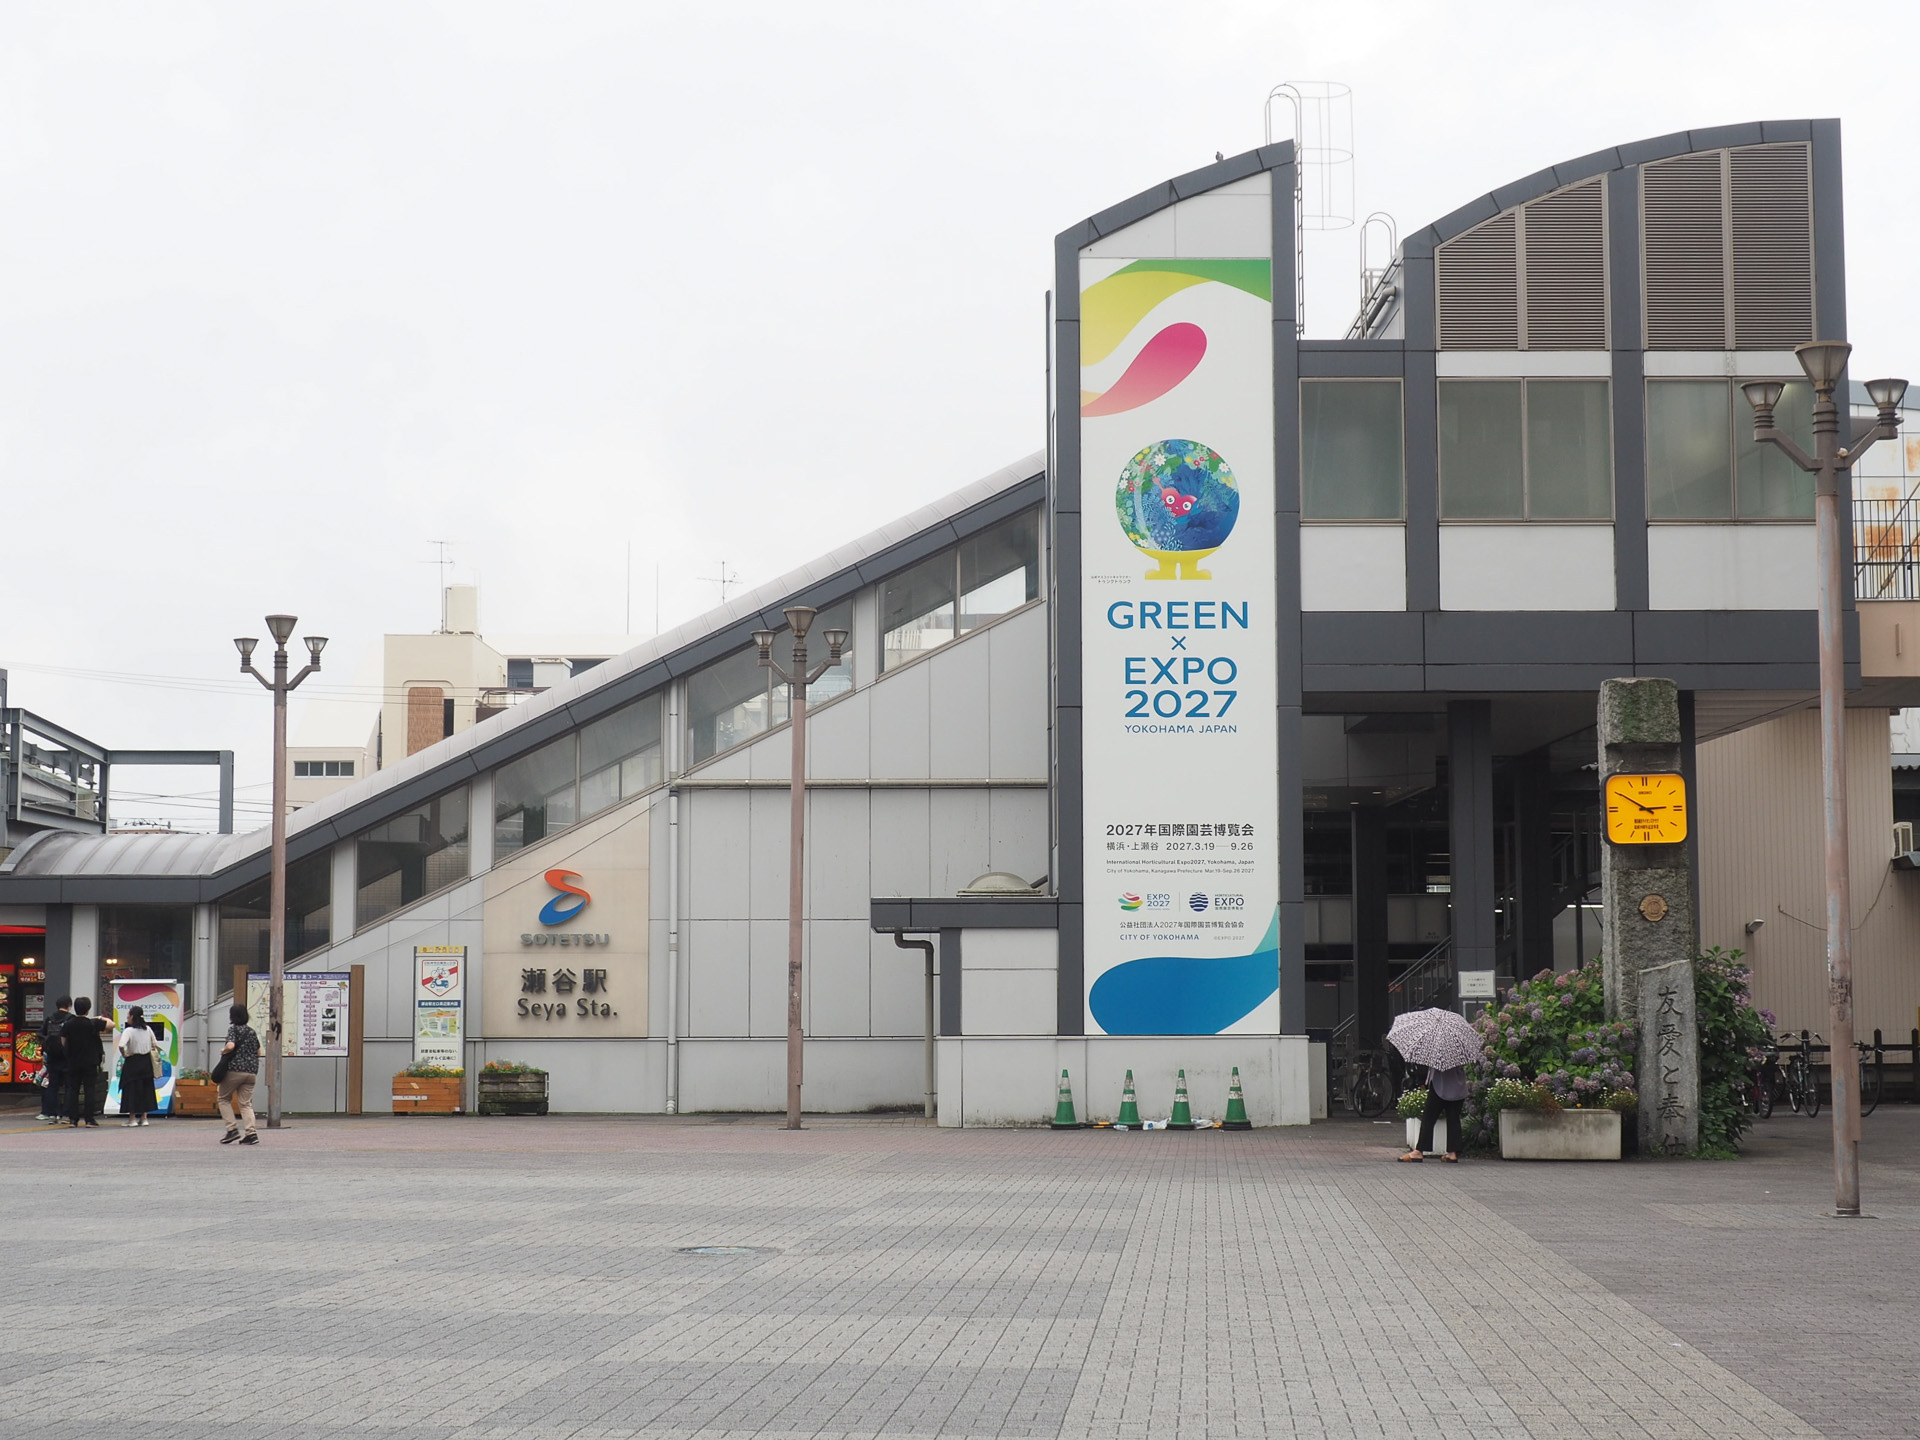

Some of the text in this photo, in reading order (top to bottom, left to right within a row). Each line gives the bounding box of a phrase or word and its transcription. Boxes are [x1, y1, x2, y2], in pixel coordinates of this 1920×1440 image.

[1107, 601, 1248, 629] GREEN
[1125, 657, 1238, 685] EXPO
[1125, 690, 1237, 718] 2027
[1125, 725, 1237, 733] YOKOHAMA JAPAN
[1106, 823, 1254, 837] 2027年国際園芸博覧会
[1106, 841, 1159, 851] 横浜・上瀬谷
[1214, 898, 1245, 906] EXPO
[520, 933, 610, 947] SOTETSU
[521, 968, 608, 993] 瀬谷駅
[517, 998, 618, 1021] Seya Sta.
[1656, 986, 1687, 1156] 友愛と奉仕
